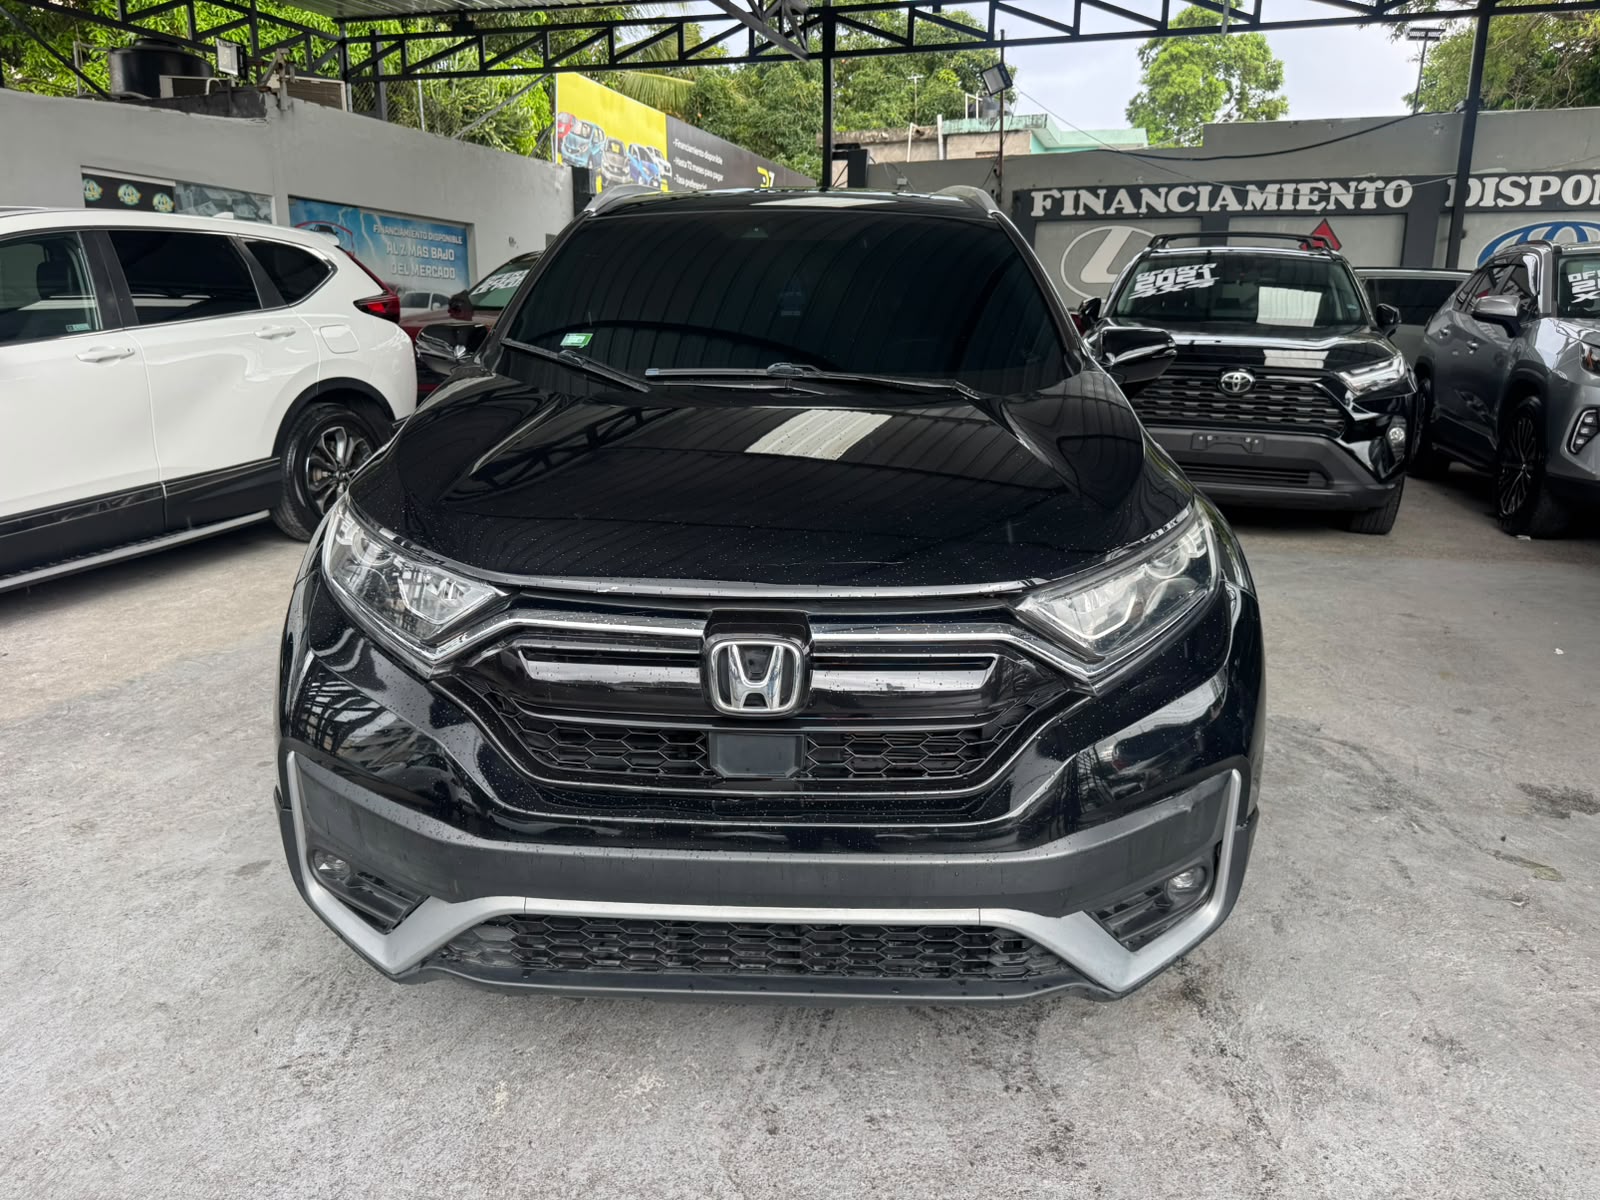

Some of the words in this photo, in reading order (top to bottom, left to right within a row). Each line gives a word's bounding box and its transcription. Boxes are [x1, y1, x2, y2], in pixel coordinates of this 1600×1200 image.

[1031, 180, 1413, 217] FINANCIAMIENTO
[373, 224, 428, 240] FINANCIAMIENTO
[428, 232, 463, 245] DISPONIBLE
[386, 241, 398, 255] AL
[431, 247, 455, 261] BAJO
[391, 263, 409, 276] DEL
[411, 264, 456, 279] MERCADO
[1134, 268, 1212, 291] 2021
[1568, 269, 1600, 283] OF
[1571, 278, 1600, 294] 2
